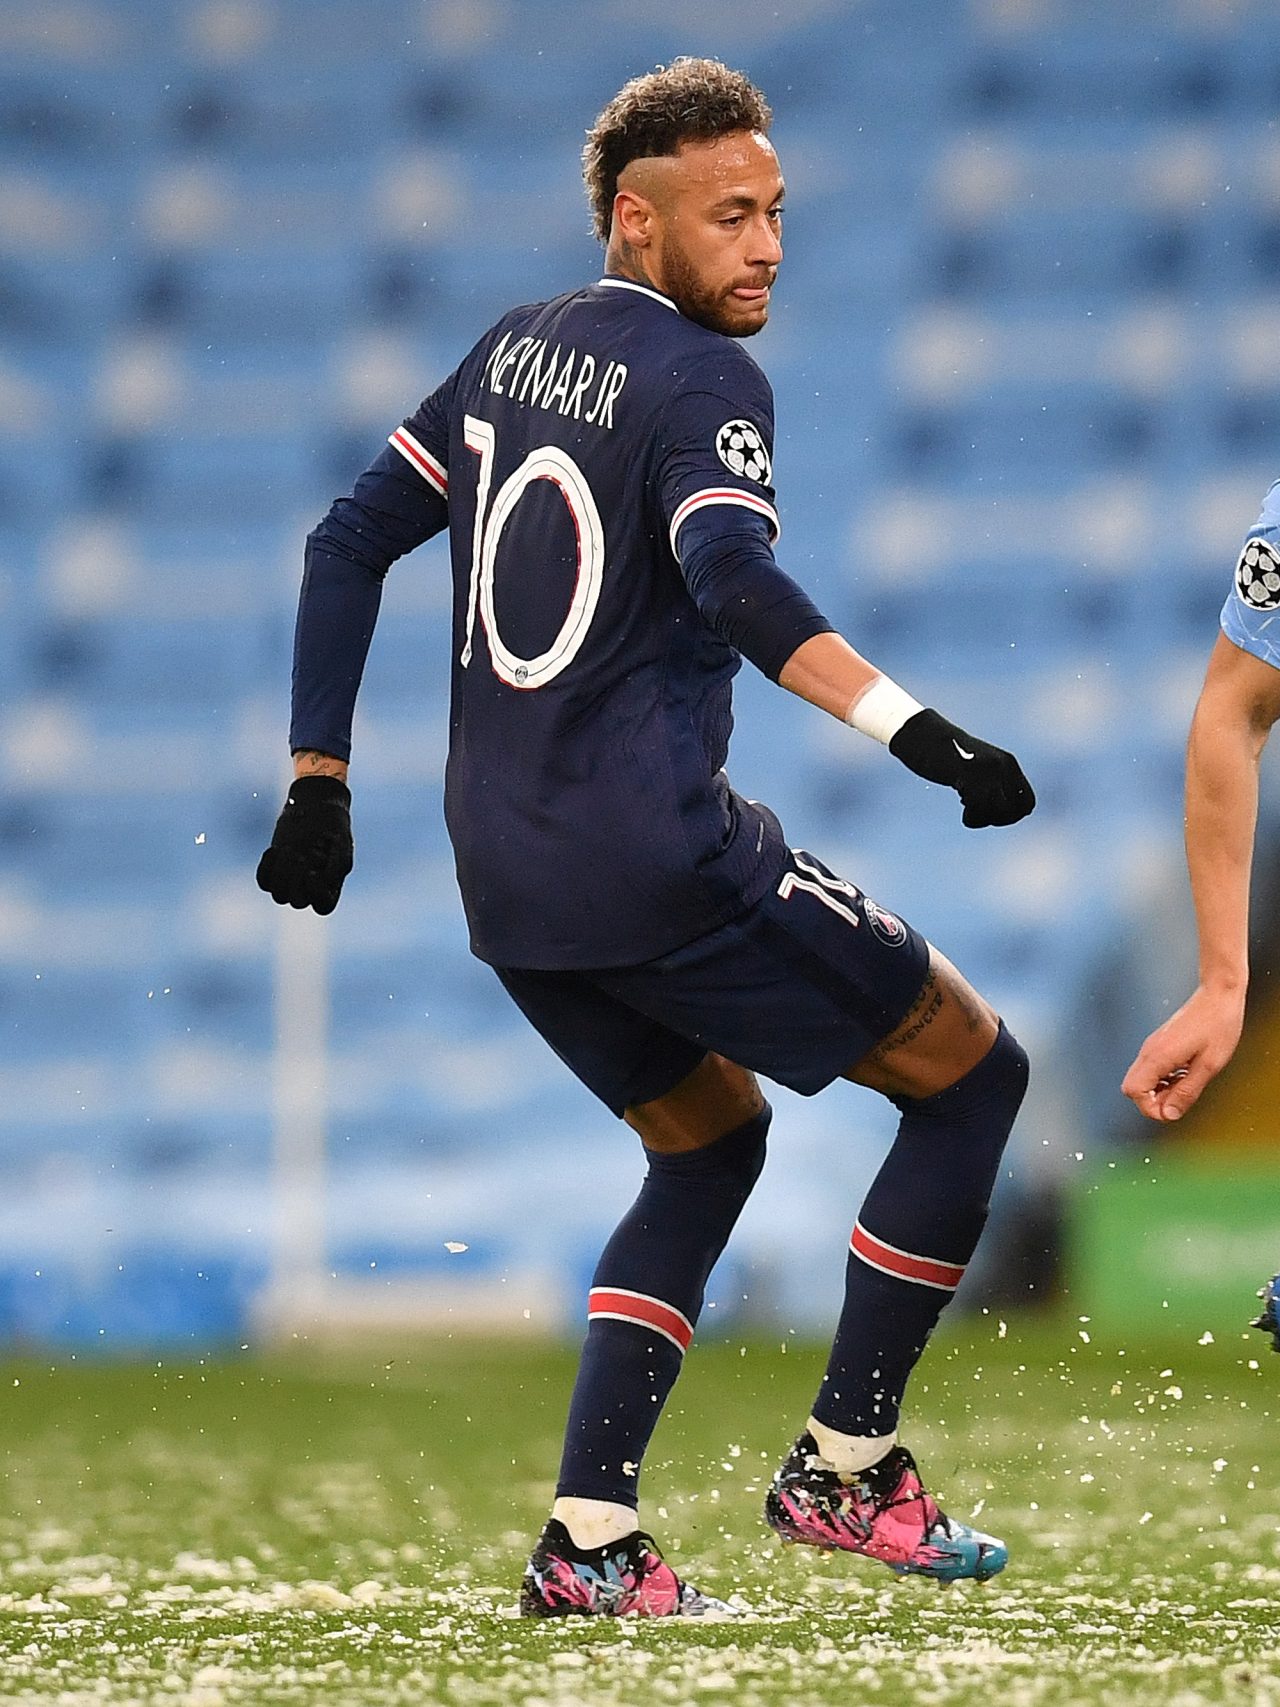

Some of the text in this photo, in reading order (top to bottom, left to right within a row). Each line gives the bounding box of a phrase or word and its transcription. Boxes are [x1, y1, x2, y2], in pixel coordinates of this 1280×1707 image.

[480, 331, 629, 430] NEYMAR JR
[460, 413, 605, 692] 10
